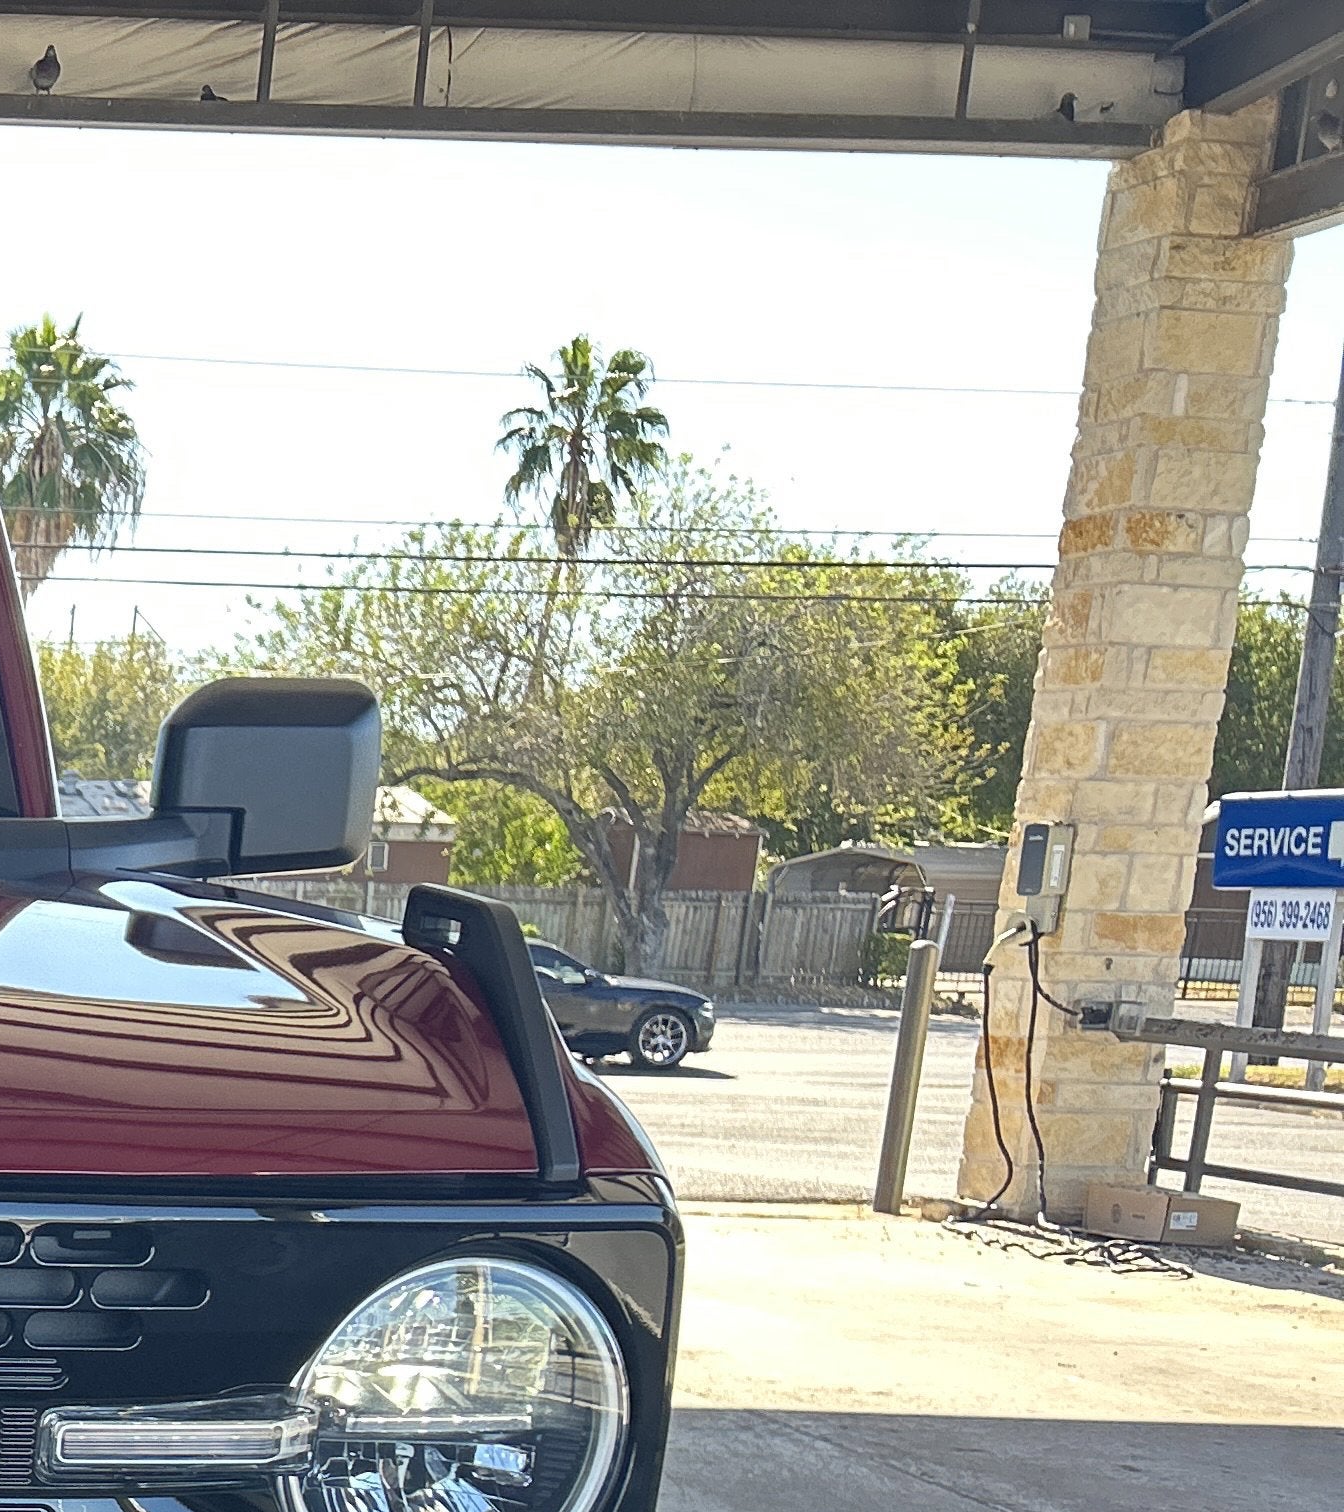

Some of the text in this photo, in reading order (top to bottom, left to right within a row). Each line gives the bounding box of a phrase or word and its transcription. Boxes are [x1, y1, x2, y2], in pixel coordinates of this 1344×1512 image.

[1224, 826, 1324, 856] SERVICE
[1250, 900, 1331, 929] (956) 399-2468
